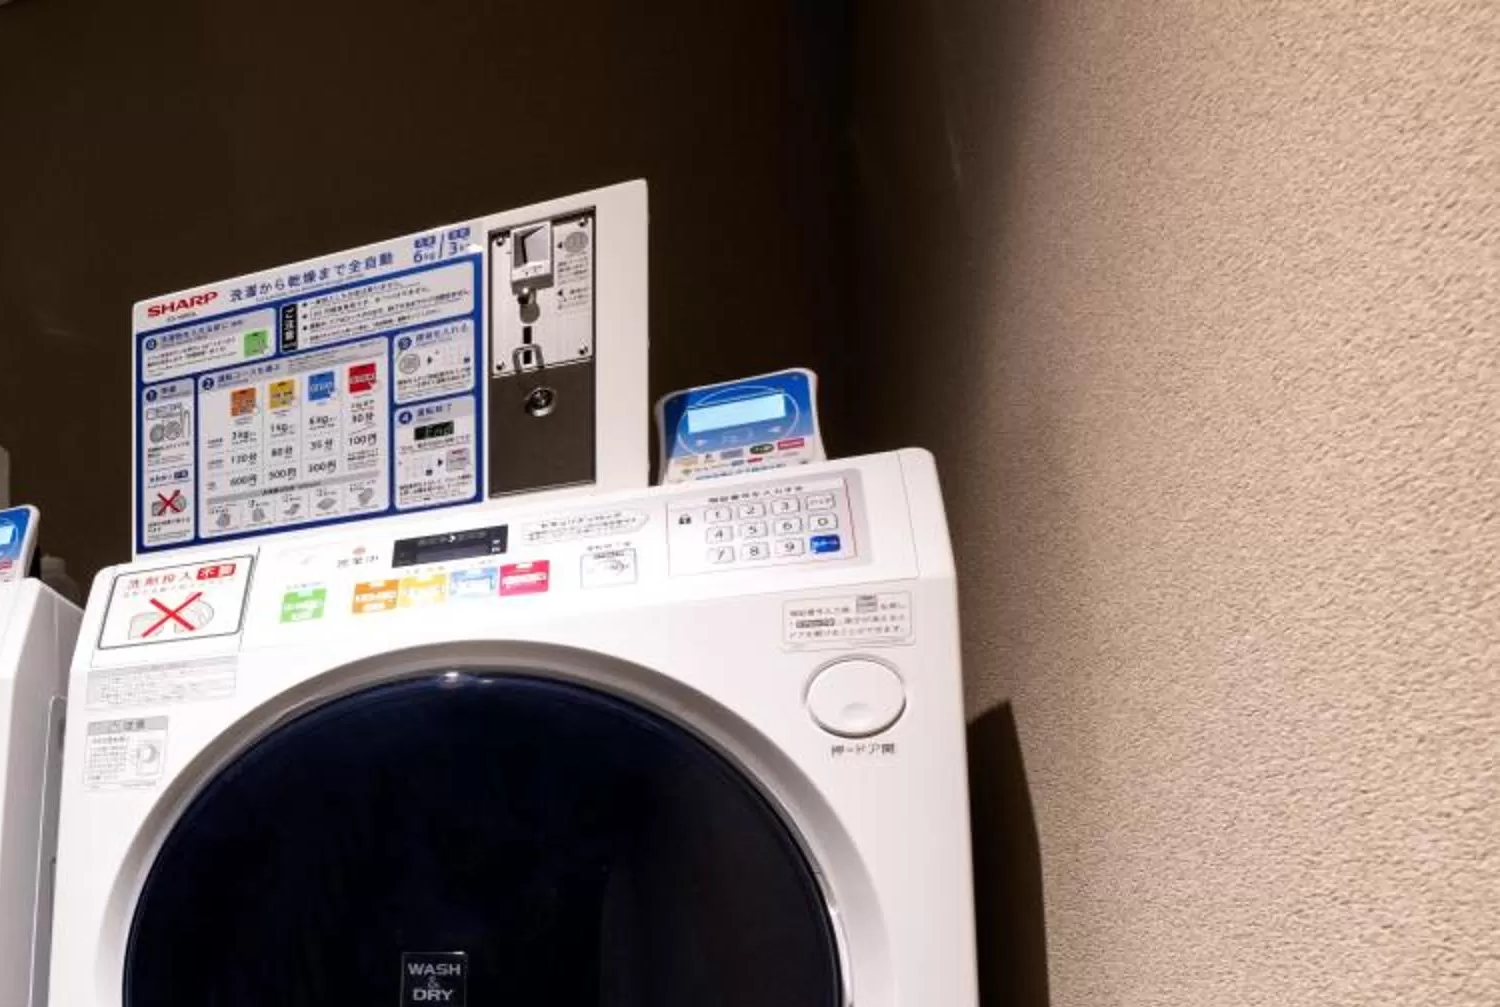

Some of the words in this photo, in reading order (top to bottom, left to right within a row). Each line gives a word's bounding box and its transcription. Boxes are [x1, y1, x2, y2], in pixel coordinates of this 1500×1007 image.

[147, 291, 218, 318] SHARP
[407, 963, 461, 975] WASH
[413, 988, 453, 1001] DRY
